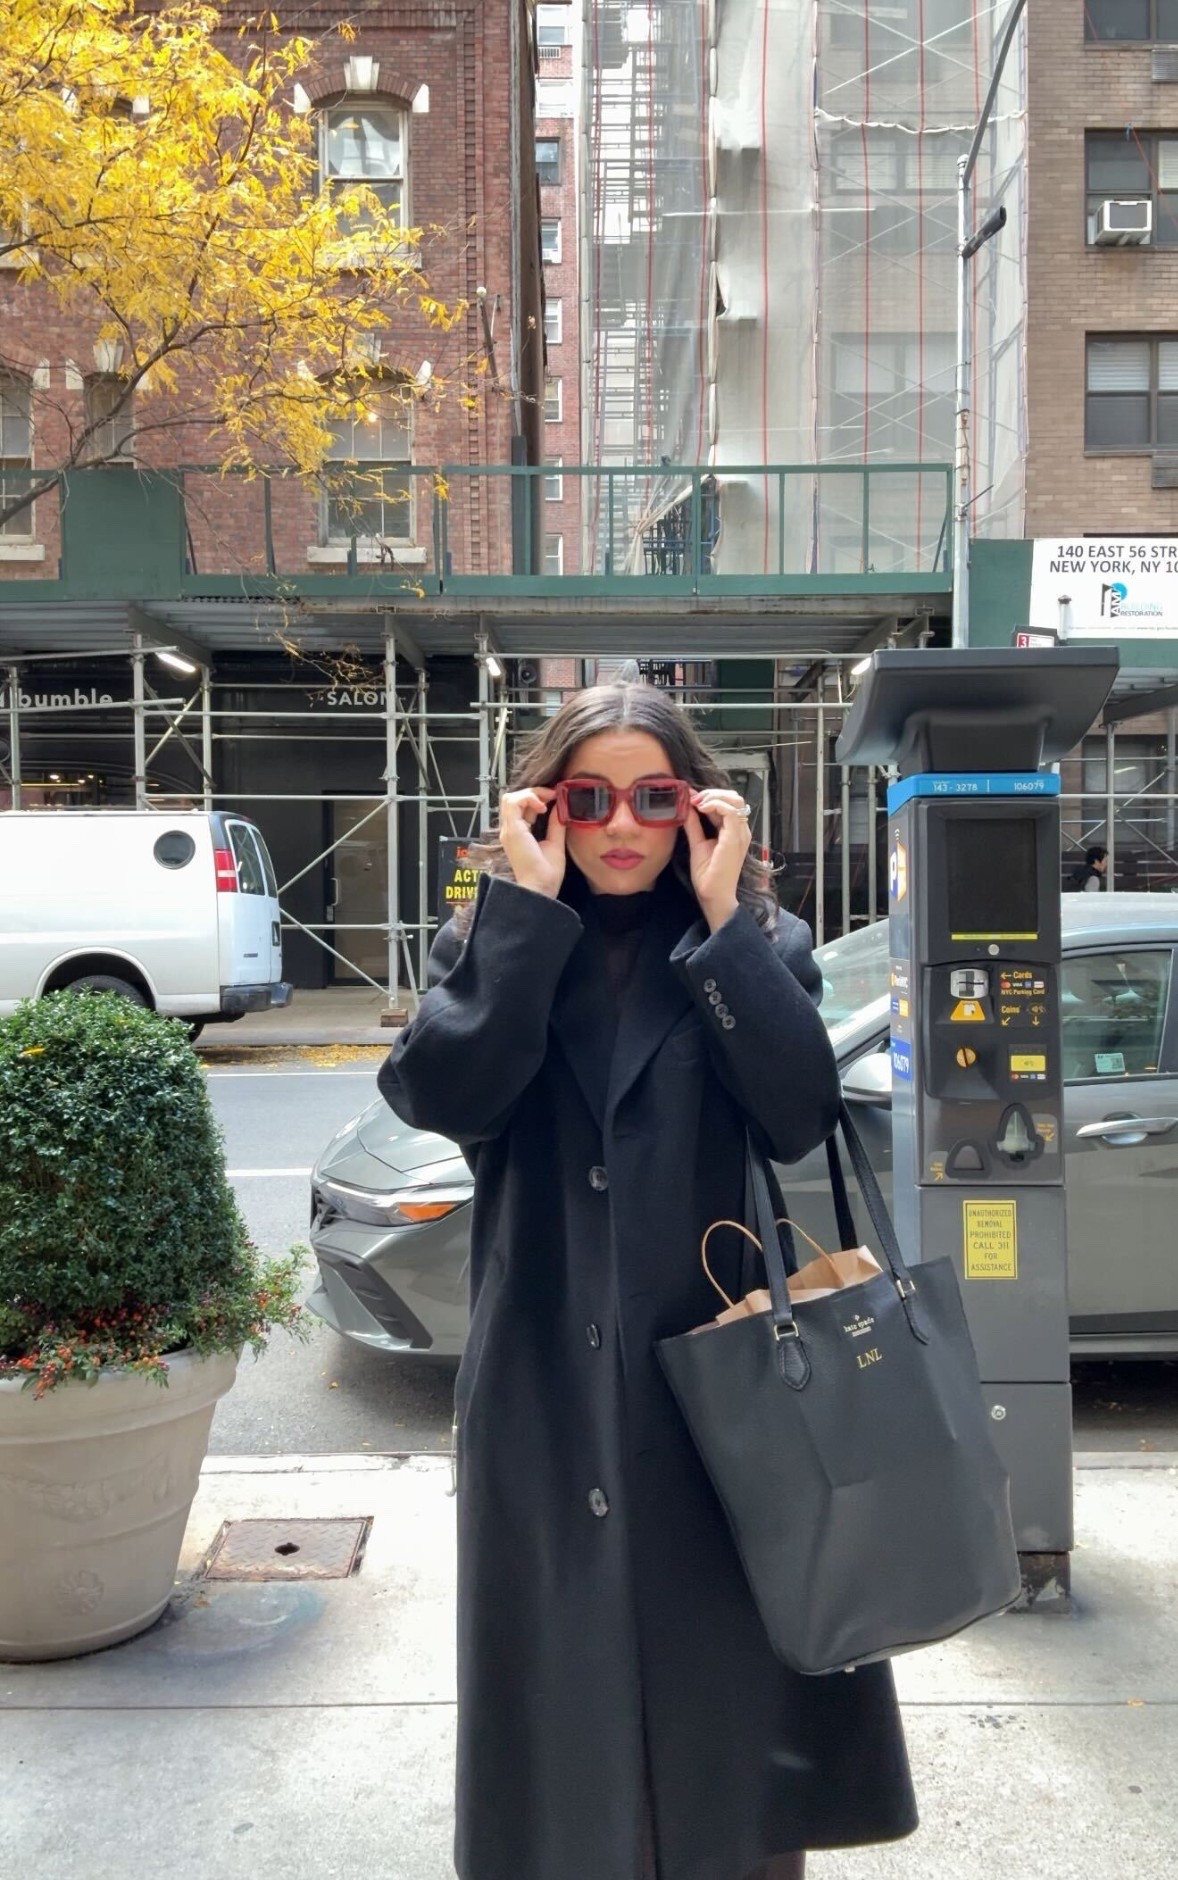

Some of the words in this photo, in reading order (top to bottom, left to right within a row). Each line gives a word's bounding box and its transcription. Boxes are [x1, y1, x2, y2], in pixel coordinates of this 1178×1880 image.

[1057, 545, 1084, 558] 140
[1088, 545, 1124, 558] EAST
[1129, 545, 1146, 558] 56
[1050, 560, 1086, 573] NEW
[1090, 560, 1136, 576] YORK,
[1140, 560, 1161, 573] NY
[18, 688, 113, 708] bumble
[933, 783, 948, 792] 143
[956, 783, 978, 792] 3278
[1013, 782, 1045, 792] 106079
[969, 1209, 1012, 1217] UNAUTHORIZED
[970, 1230, 1011, 1239] PROHIBITED
[973, 1242, 995, 1250] CALL
[984, 1252, 998, 1260] FOR
[971, 1263, 1012, 1272] ASSISTANCE
[856, 1347, 883, 1369] LNL
